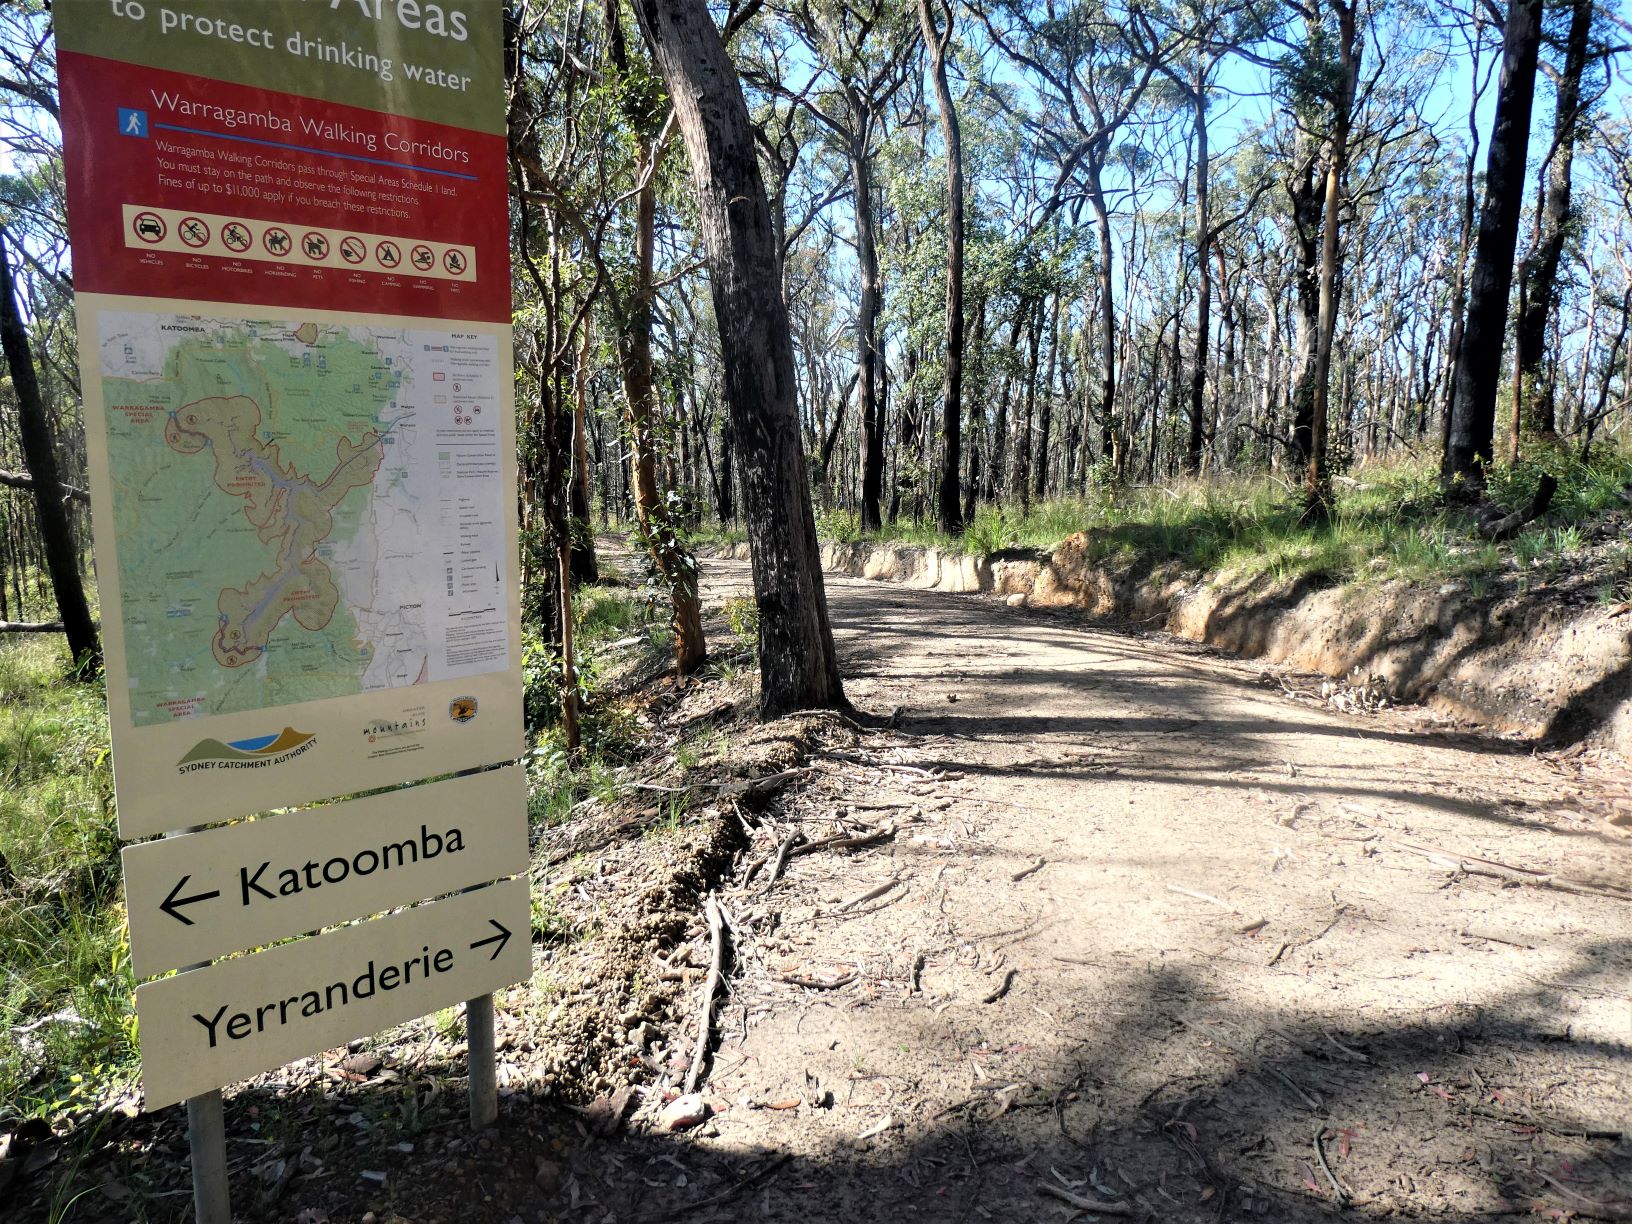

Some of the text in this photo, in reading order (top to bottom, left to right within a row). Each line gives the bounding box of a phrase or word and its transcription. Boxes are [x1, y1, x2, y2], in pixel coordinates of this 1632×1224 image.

[111, 0, 471, 91] to protect drinking water
[151, 88, 469, 163] Warragamba Walking Corridors
[155, 139, 215, 159] Warragamba
[217, 149, 252, 167] Walking
[254, 155, 296, 172] Corridors
[298, 165, 315, 178] pass
[317, 166, 349, 182] through
[350, 170, 376, 186] Special
[378, 175, 400, 188] Areas
[401, 178, 433, 193] Schedule
[441, 185, 458, 197] land.
[157, 156, 420, 206] You must stay on the path and observe the following restrictions.
[158, 174, 411, 219] Fines of up to $11,000 apply if you breach these restrictions.
[161, 324, 206, 333] KATOOMBA
[466, 333, 478, 341] KEY
[399, 603, 422, 611] PICTON
[363, 717, 427, 736] mountains
[179, 738, 318, 775] SYDNEY CATCHMENT AUTHORITY
[240, 824, 465, 906] Katoomba
[192, 945, 454, 1049] Yerranderie
